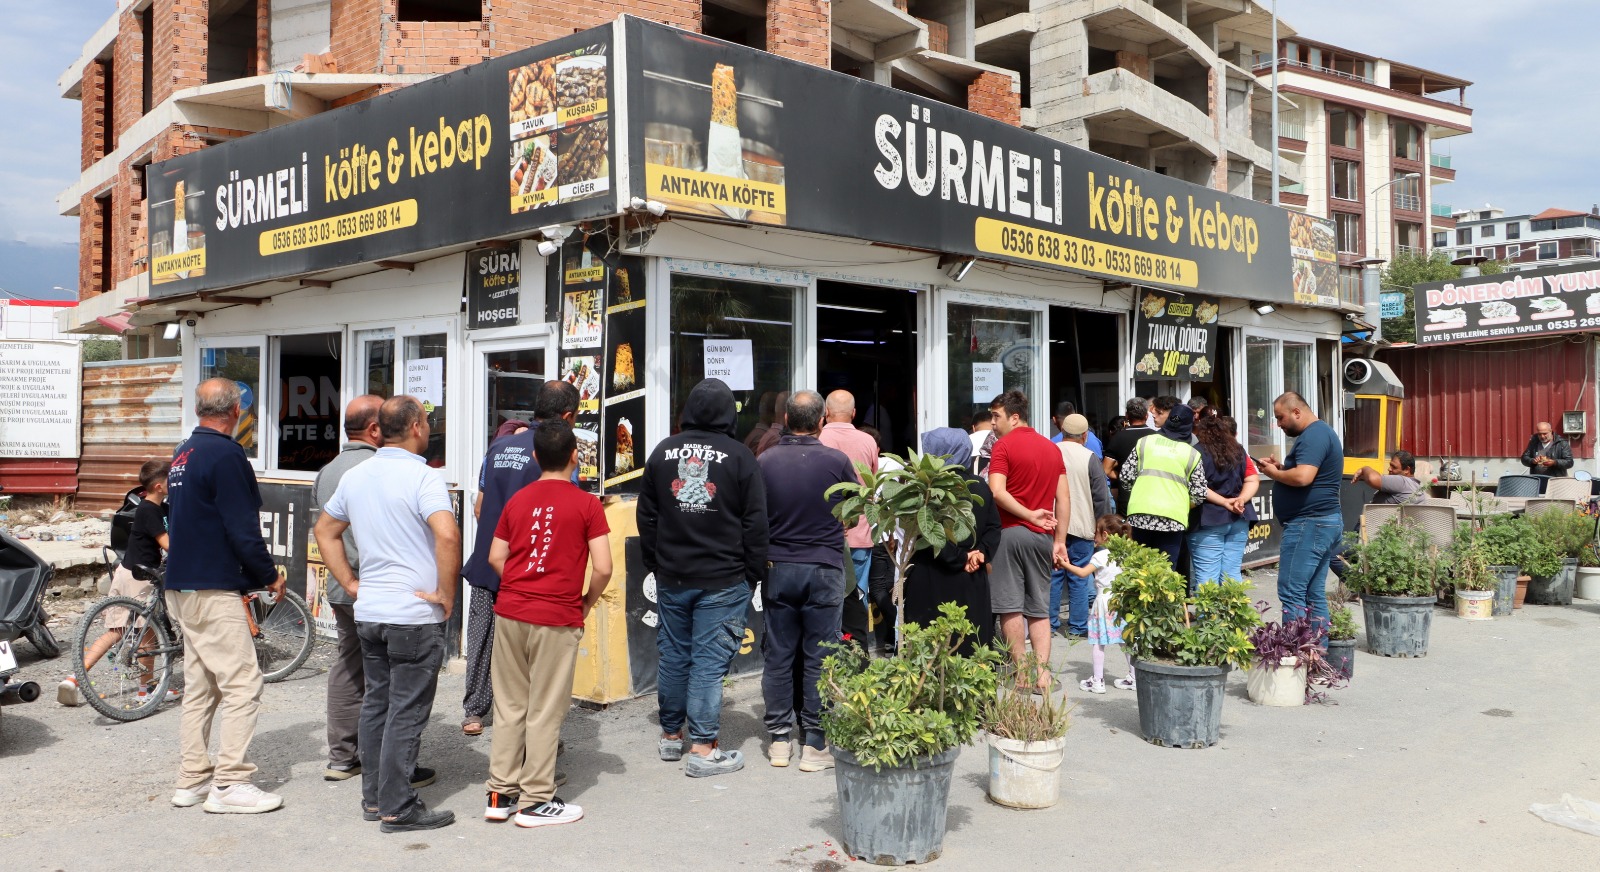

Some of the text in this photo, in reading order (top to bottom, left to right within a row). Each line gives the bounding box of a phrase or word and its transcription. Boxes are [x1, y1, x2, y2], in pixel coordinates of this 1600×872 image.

[522, 118, 544, 130] TAVUK
[566, 102, 598, 117] KUŞBAŞI
[324, 114, 491, 203] köfte & kebap
[874, 104, 1062, 225] SÜRMELİ
[216, 152, 308, 231] SÜRMELİ
[523, 192, 544, 204] KIYMA
[572, 182, 594, 194] CİĞER
[660, 174, 775, 208] ANTAKYA KÖFTE
[272, 230, 291, 250] 0536
[292, 228, 307, 245] 638
[308, 224, 319, 242] 33
[320, 222, 330, 240] 03
[337, 217, 357, 238] 0533
[359, 212, 374, 232] 669
[377, 209, 387, 228] 88
[390, 206, 401, 226] 14
[1088, 172, 1259, 263] köfte & kebap
[156, 254, 201, 274] ANTAKYA KÖFTE
[1002, 226, 1033, 255] 0536
[1038, 234, 1060, 260] 638
[1064, 240, 1077, 263] 33
[1081, 243, 1095, 267] 03
[1105, 251, 1131, 273] 0533
[1134, 256, 1152, 276] 669
[1155, 260, 1167, 279] 88
[1170, 262, 1181, 281] 14
[484, 274, 505, 288] köfte
[508, 273, 514, 284] &
[1426, 275, 1544, 308] DÖNERCİM
[478, 308, 518, 322] HOŞGEL
[1444, 333, 1450, 341] İŞ
[1452, 329, 1488, 339] YERLERİNE
[1490, 326, 1514, 336] SERVİS
[1516, 324, 1542, 333] YAPILIR
[1547, 320, 1577, 330] 0535
[1580, 317, 1600, 326] 269
[1148, 323, 1208, 353] TAVUK DÖNER
[280, 376, 340, 416] RM
[280, 424, 336, 440] FTE &
[665, 448, 728, 464] MONEY
[525, 508, 542, 572] HATAY
